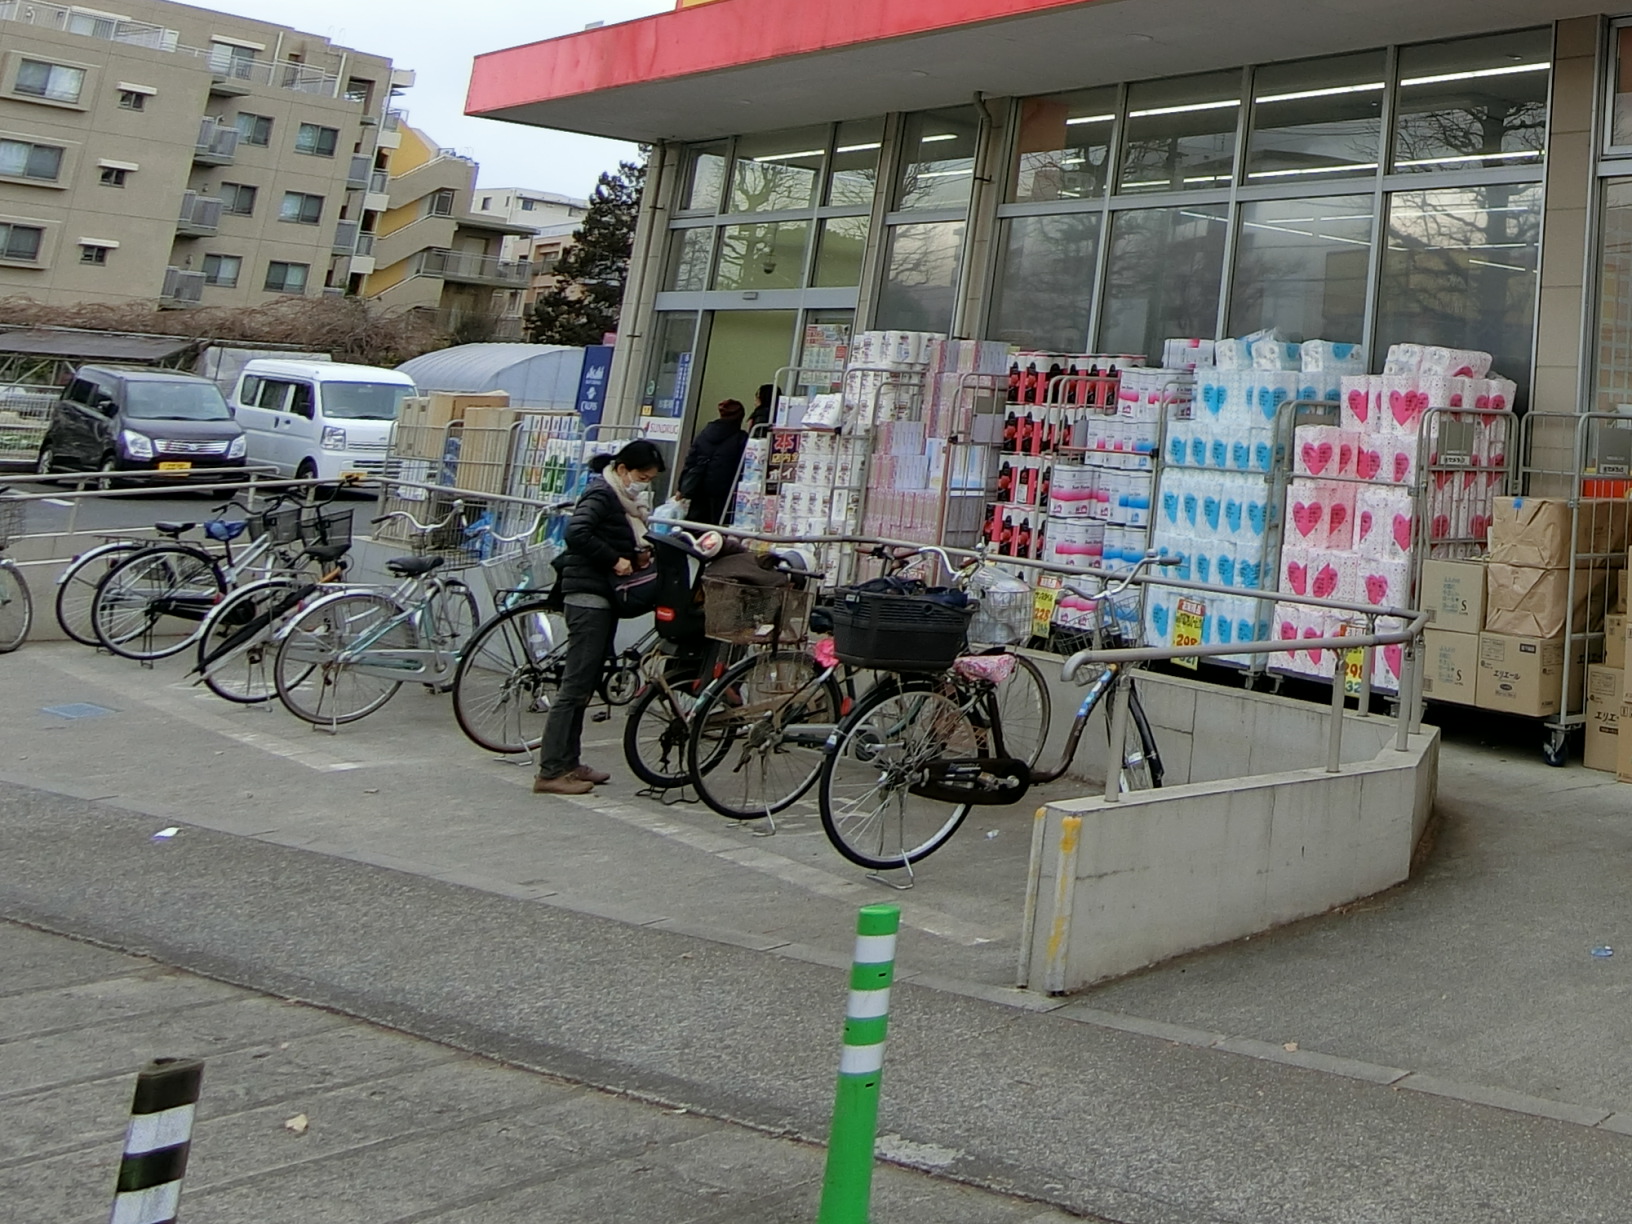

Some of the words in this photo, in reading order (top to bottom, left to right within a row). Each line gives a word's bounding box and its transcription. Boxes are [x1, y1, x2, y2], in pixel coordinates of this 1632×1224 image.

[1493, 669, 1521, 681] エリエール
